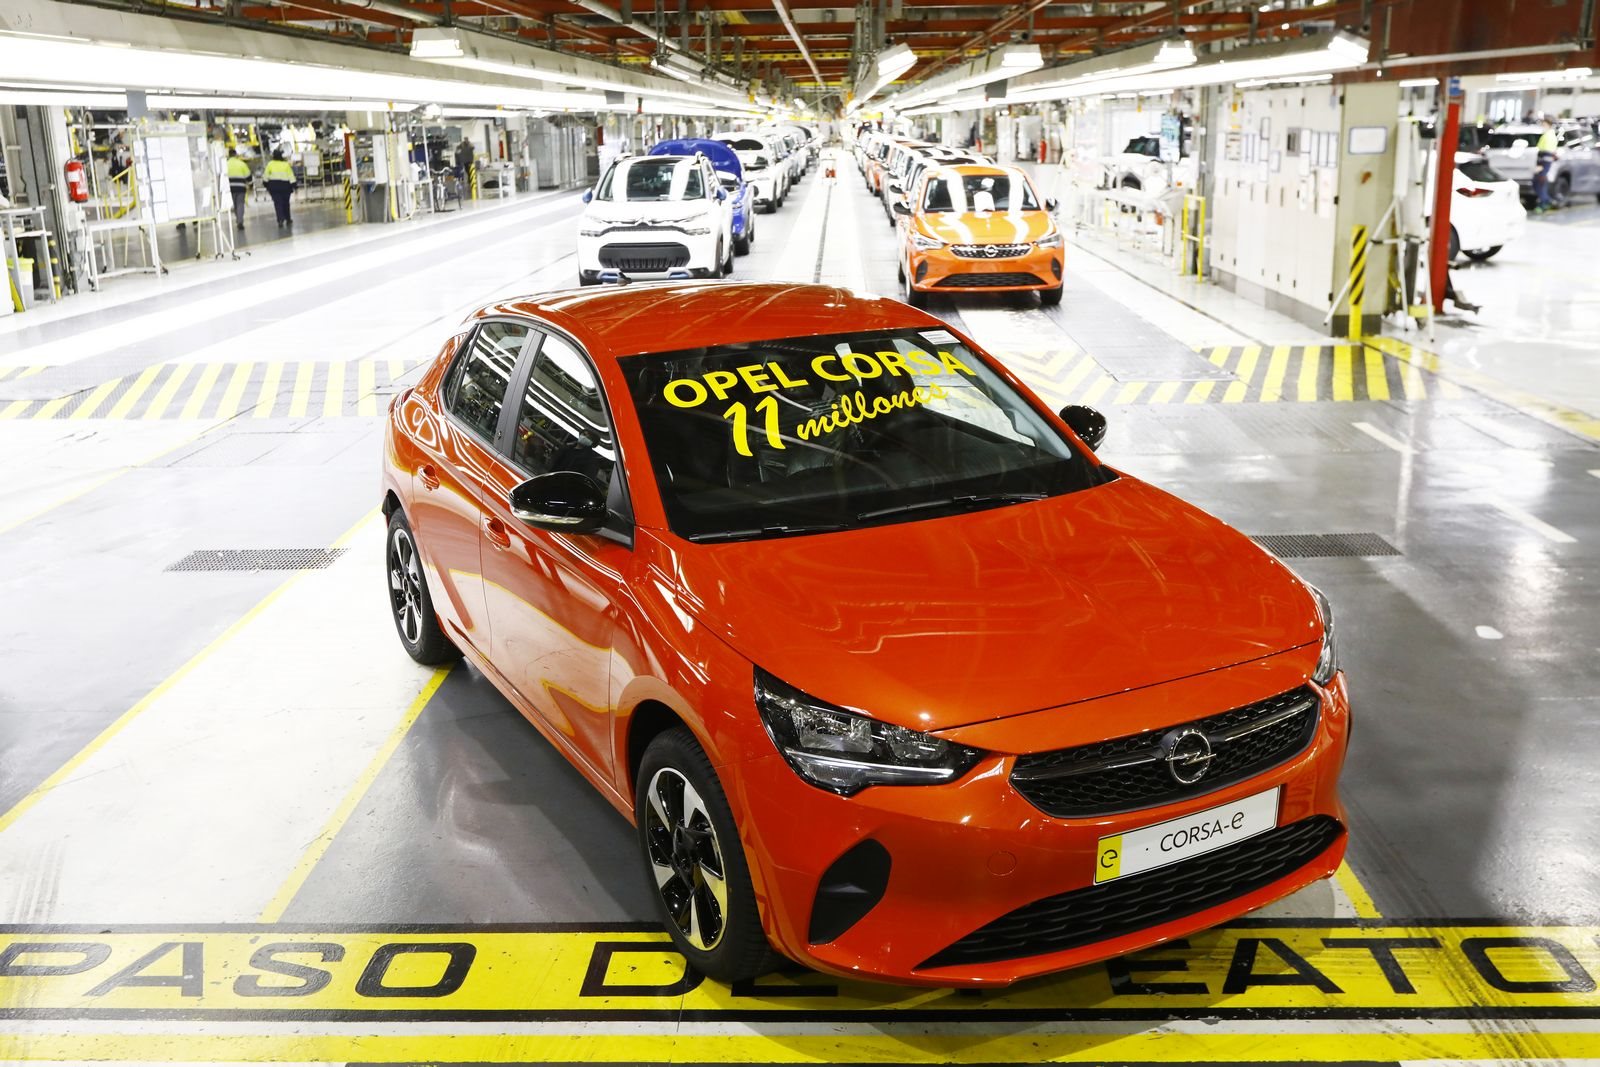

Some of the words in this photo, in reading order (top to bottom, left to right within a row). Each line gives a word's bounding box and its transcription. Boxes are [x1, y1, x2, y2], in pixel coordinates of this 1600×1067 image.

[663, 362, 808, 408] OPEL
[811, 351, 977, 381] CORSA
[723, 395, 786, 457] 11
[796, 382, 949, 440] millones
[1160, 811, 1245, 852] CORSA-e
[0, 940, 478, 997] PASO
[579, 941, 839, 997] D
[955, 937, 1600, 995] EATO
